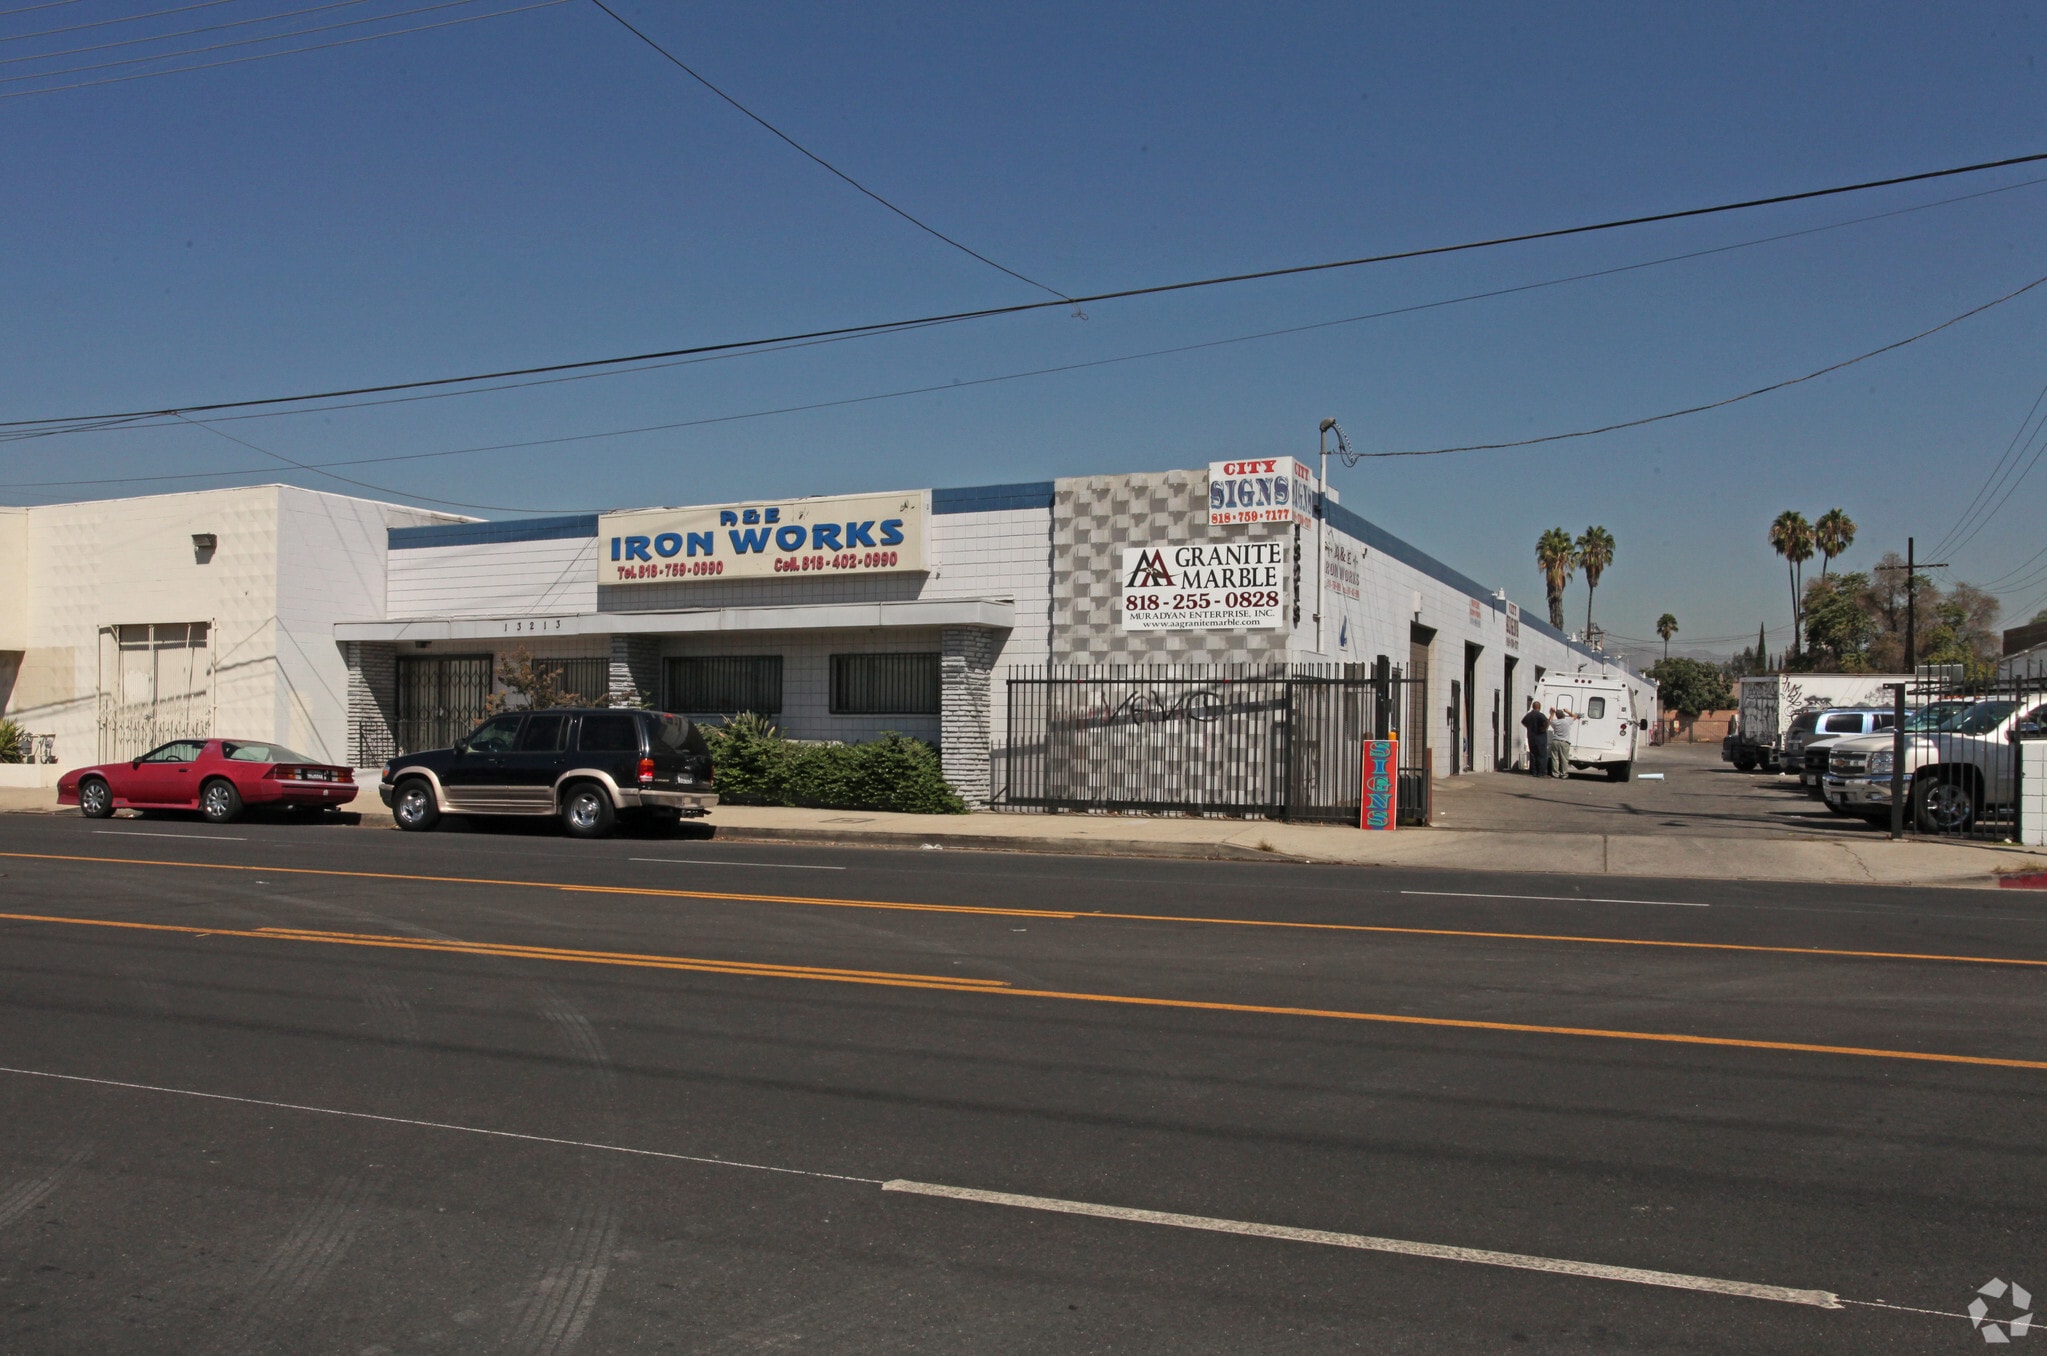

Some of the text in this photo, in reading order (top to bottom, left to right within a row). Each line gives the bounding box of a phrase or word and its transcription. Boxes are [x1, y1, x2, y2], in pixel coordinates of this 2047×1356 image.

[1224, 460, 1276, 475] CITY
[1210, 476, 1289, 509] SIGNS
[611, 519, 904, 562] IRON WORKS
[1175, 544, 1281, 567] GRANITE
[1181, 566, 1277, 589] MARBLE
[504, 620, 561, 632] 13213
[1130, 609, 1275, 620] MURADYAN ENTERPRISE, INC.
[1143, 618, 1261, 629] www.aagranitemarble.com
[1366, 741, 1392, 827] SIGNS
